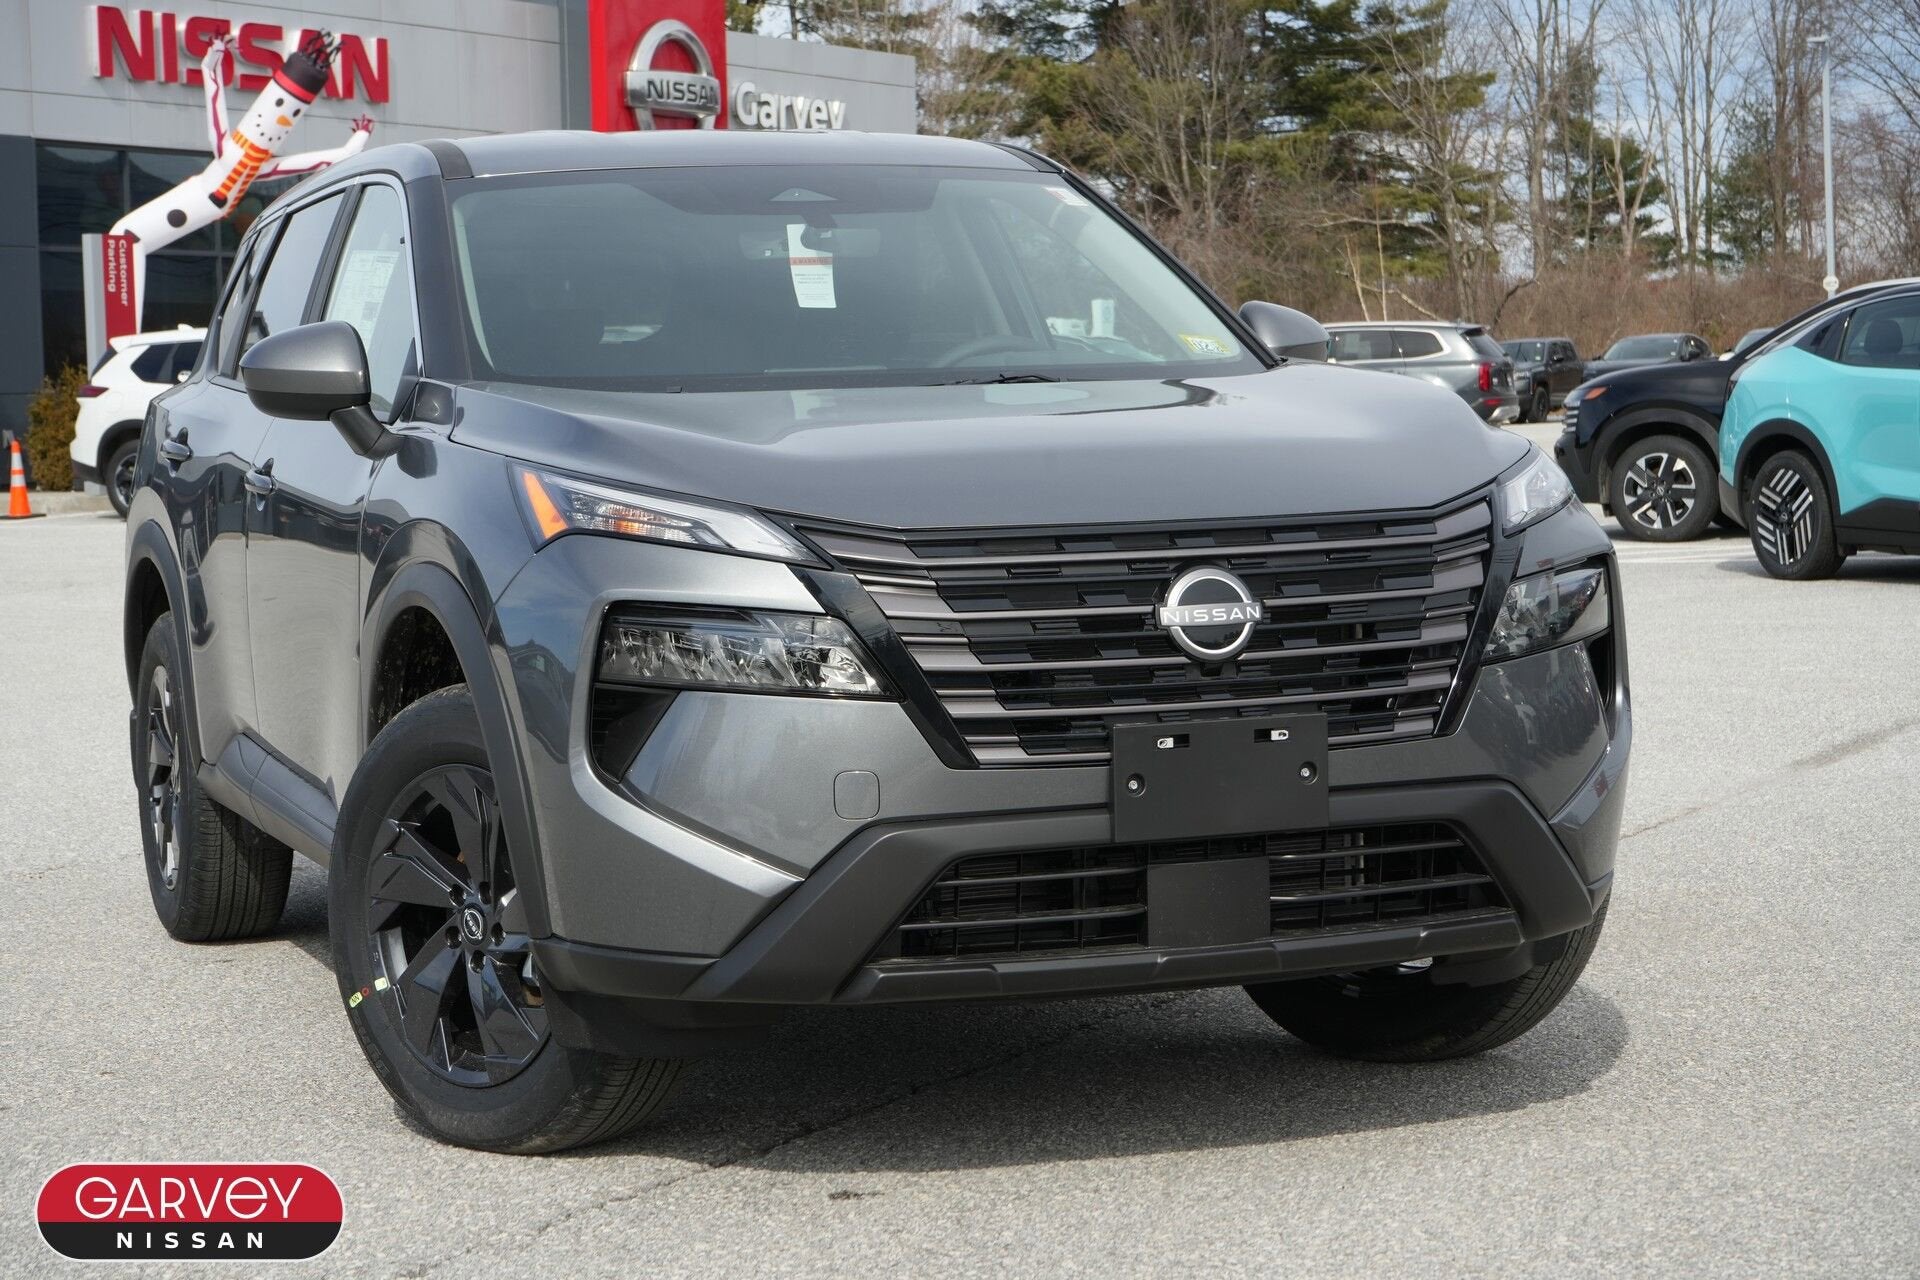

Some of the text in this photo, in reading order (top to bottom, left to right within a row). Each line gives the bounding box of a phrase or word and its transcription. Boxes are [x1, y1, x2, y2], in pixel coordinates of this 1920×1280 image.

[647, 79, 719, 104] NISSAN
[736, 82, 847, 129] Garvey
[107, 239, 117, 292] Parking
[119, 239, 128, 306] Customer
[1163, 606, 1260, 624] NISSAN
